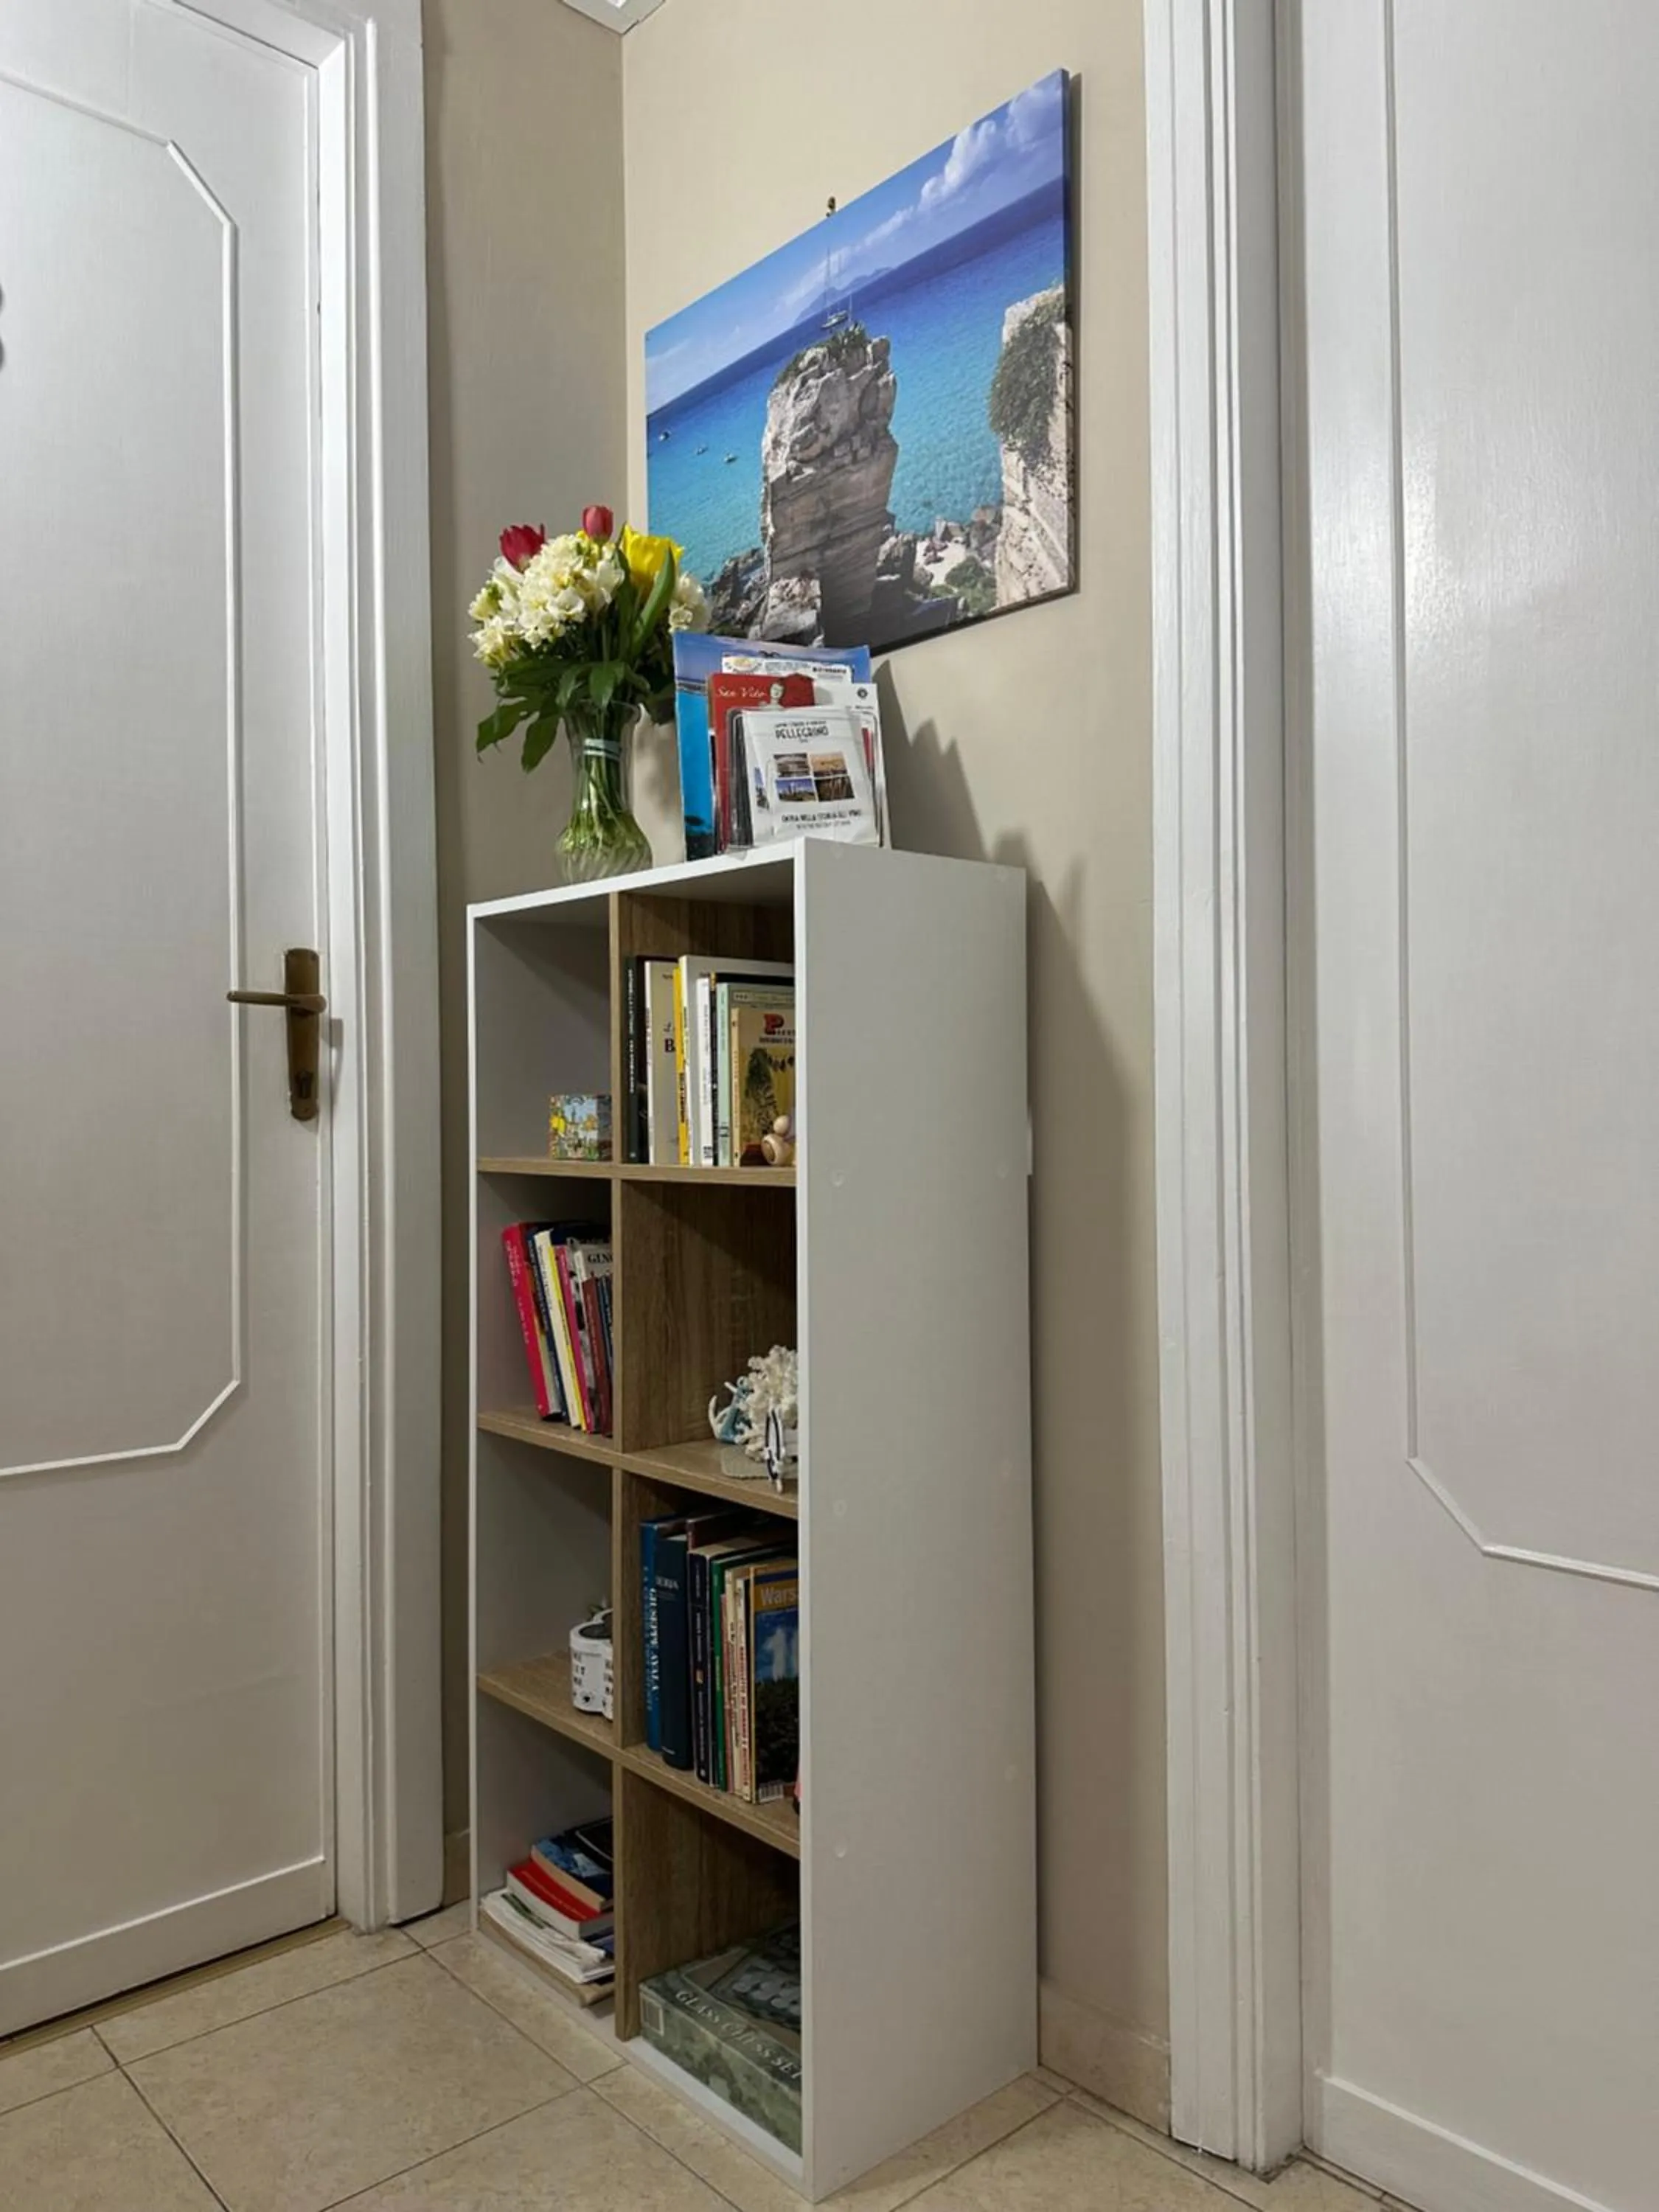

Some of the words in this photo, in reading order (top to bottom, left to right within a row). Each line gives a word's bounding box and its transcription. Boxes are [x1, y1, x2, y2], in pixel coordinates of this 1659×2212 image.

[775, 725, 829, 740] PELLEGRINO
[760, 1585, 799, 1607] Wars
[675, 1990, 720, 2023] GLASS
[721, 2022, 771, 2058] CHESS
